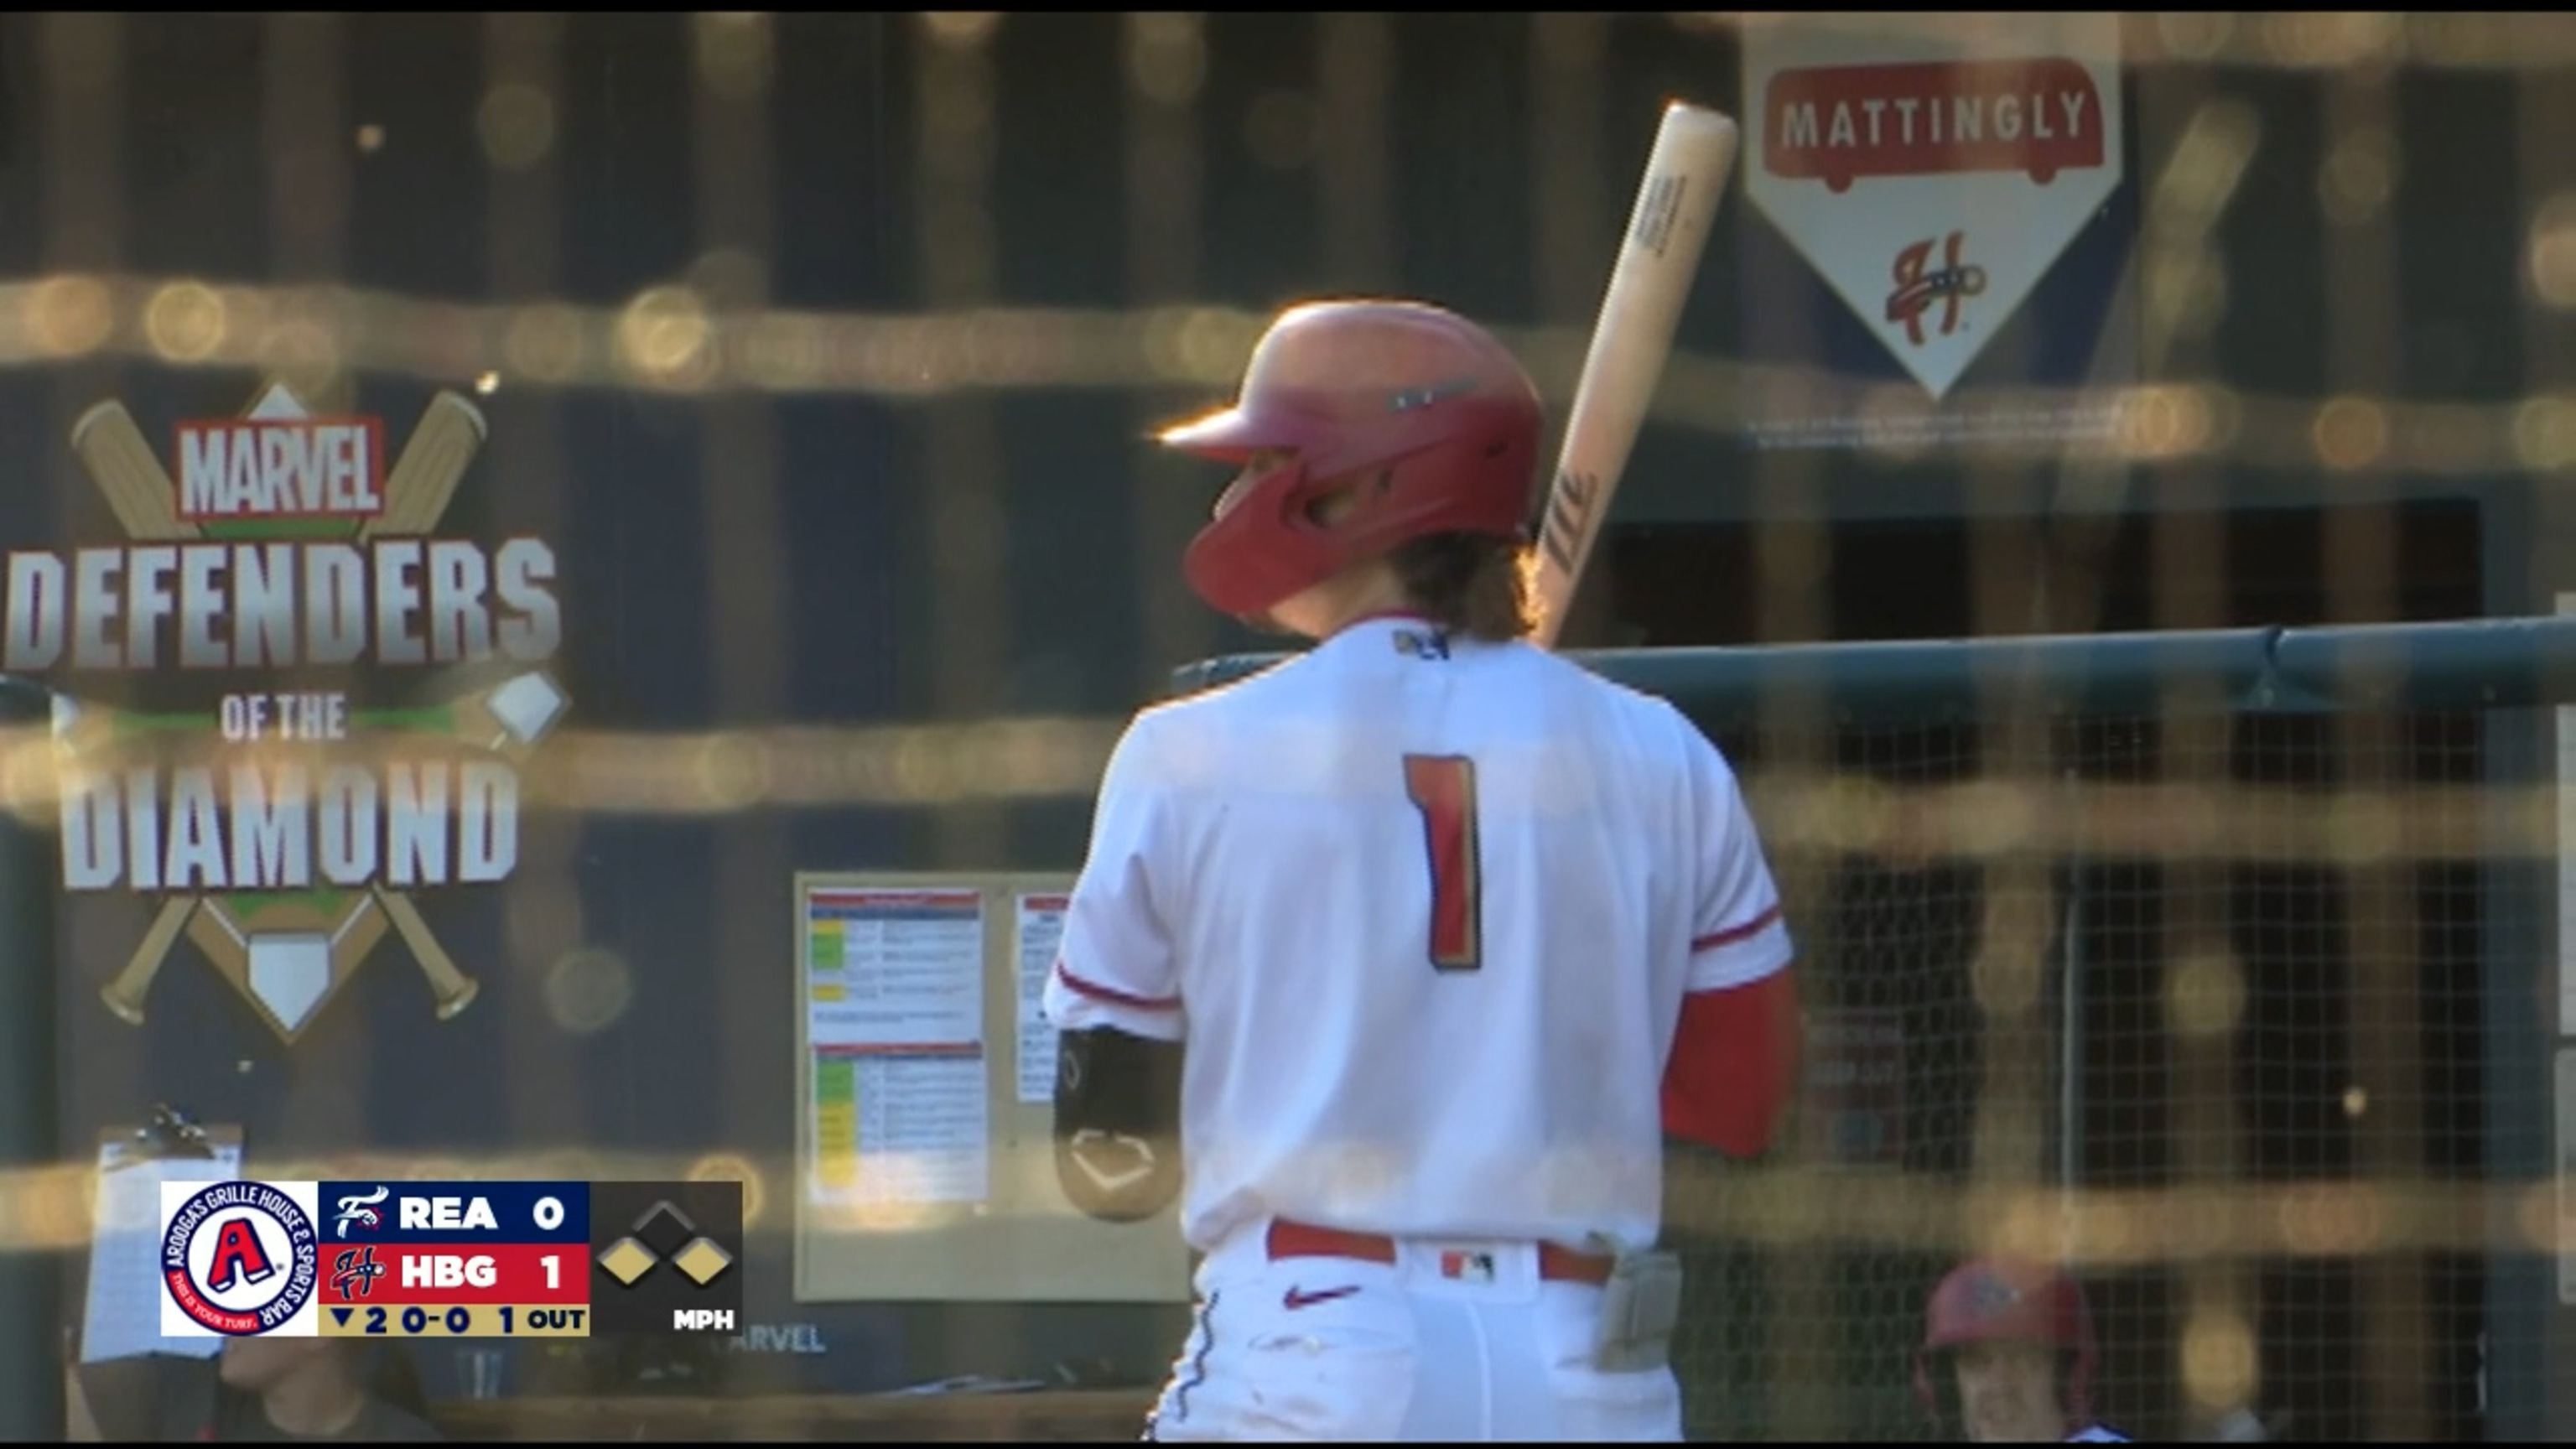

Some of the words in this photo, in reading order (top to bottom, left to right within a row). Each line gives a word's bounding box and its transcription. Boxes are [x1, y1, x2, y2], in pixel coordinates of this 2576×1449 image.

[1782, 90, 2085, 149] MATTINGLY
[178, 424, 379, 514] MARVEL
[4, 538, 562, 668] DEFENDERS
[221, 694, 267, 740] OF
[276, 692, 345, 740] THE
[57, 758, 518, 891] DIAMOND
[1402, 752, 1482, 973] 1
